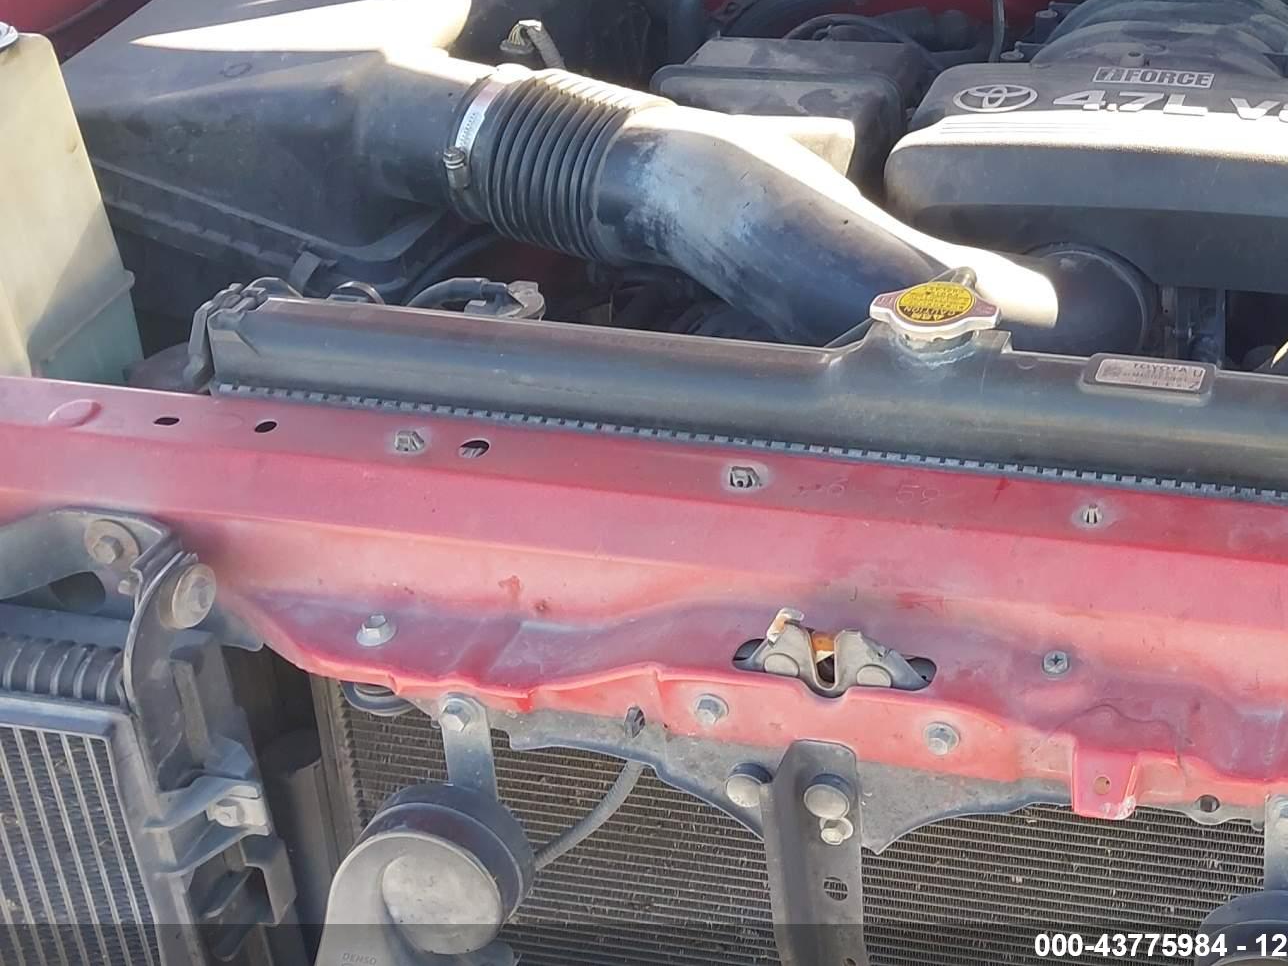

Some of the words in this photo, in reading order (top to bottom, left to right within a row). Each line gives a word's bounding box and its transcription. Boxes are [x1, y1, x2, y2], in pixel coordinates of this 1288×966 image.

[1052, 90, 1209, 116] 4.7L
[903, 305, 956, 317] CAUTION
[1133, 362, 1187, 373] TOYOTA
